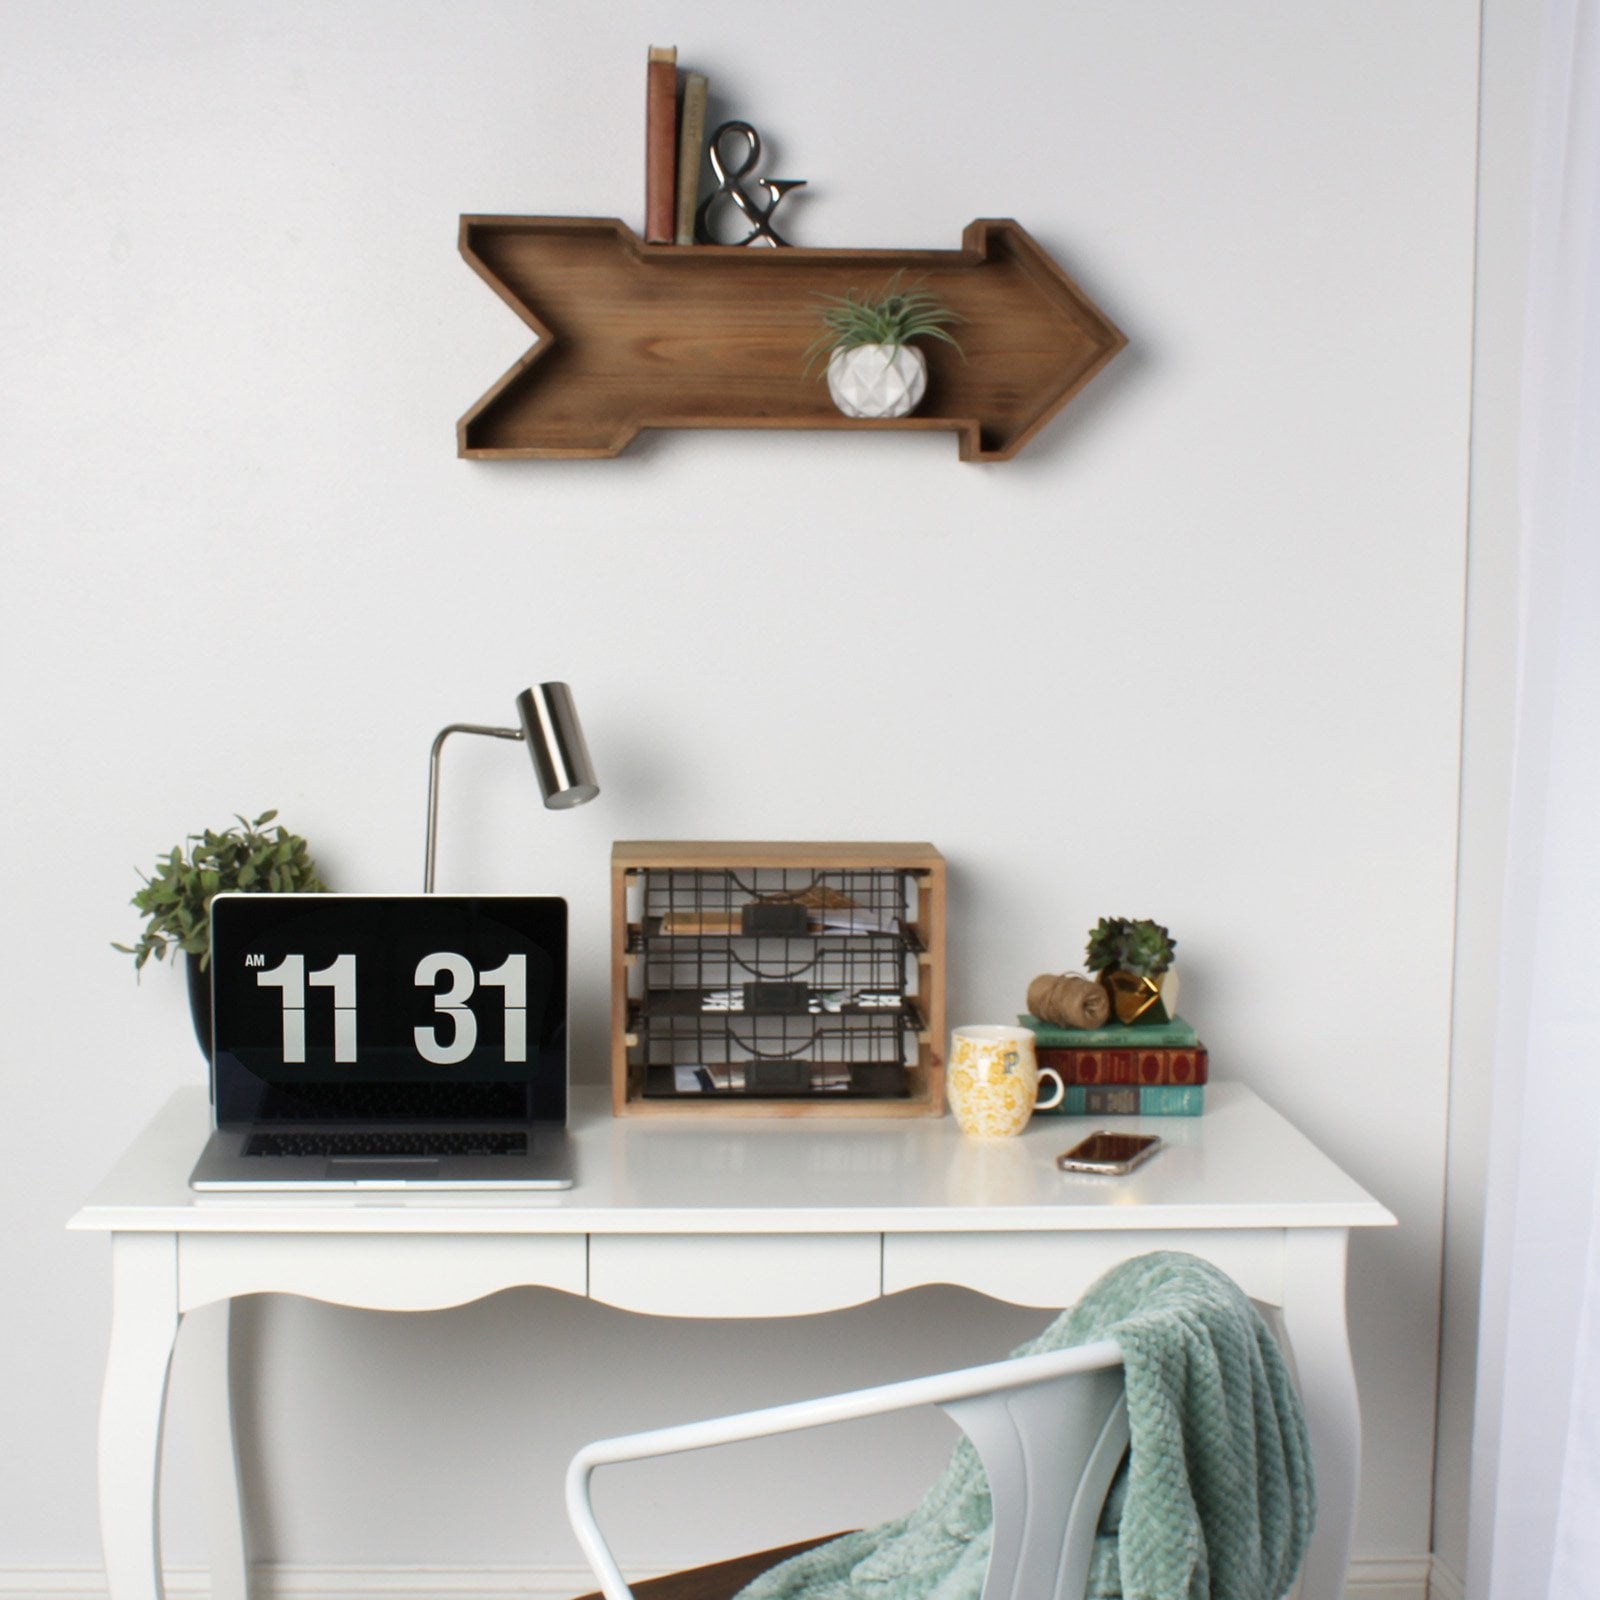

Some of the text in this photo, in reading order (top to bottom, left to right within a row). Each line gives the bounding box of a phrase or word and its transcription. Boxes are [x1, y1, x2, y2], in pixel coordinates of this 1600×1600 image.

[245, 954, 265, 967] AM
[257, 952, 527, 1065] 11 31
